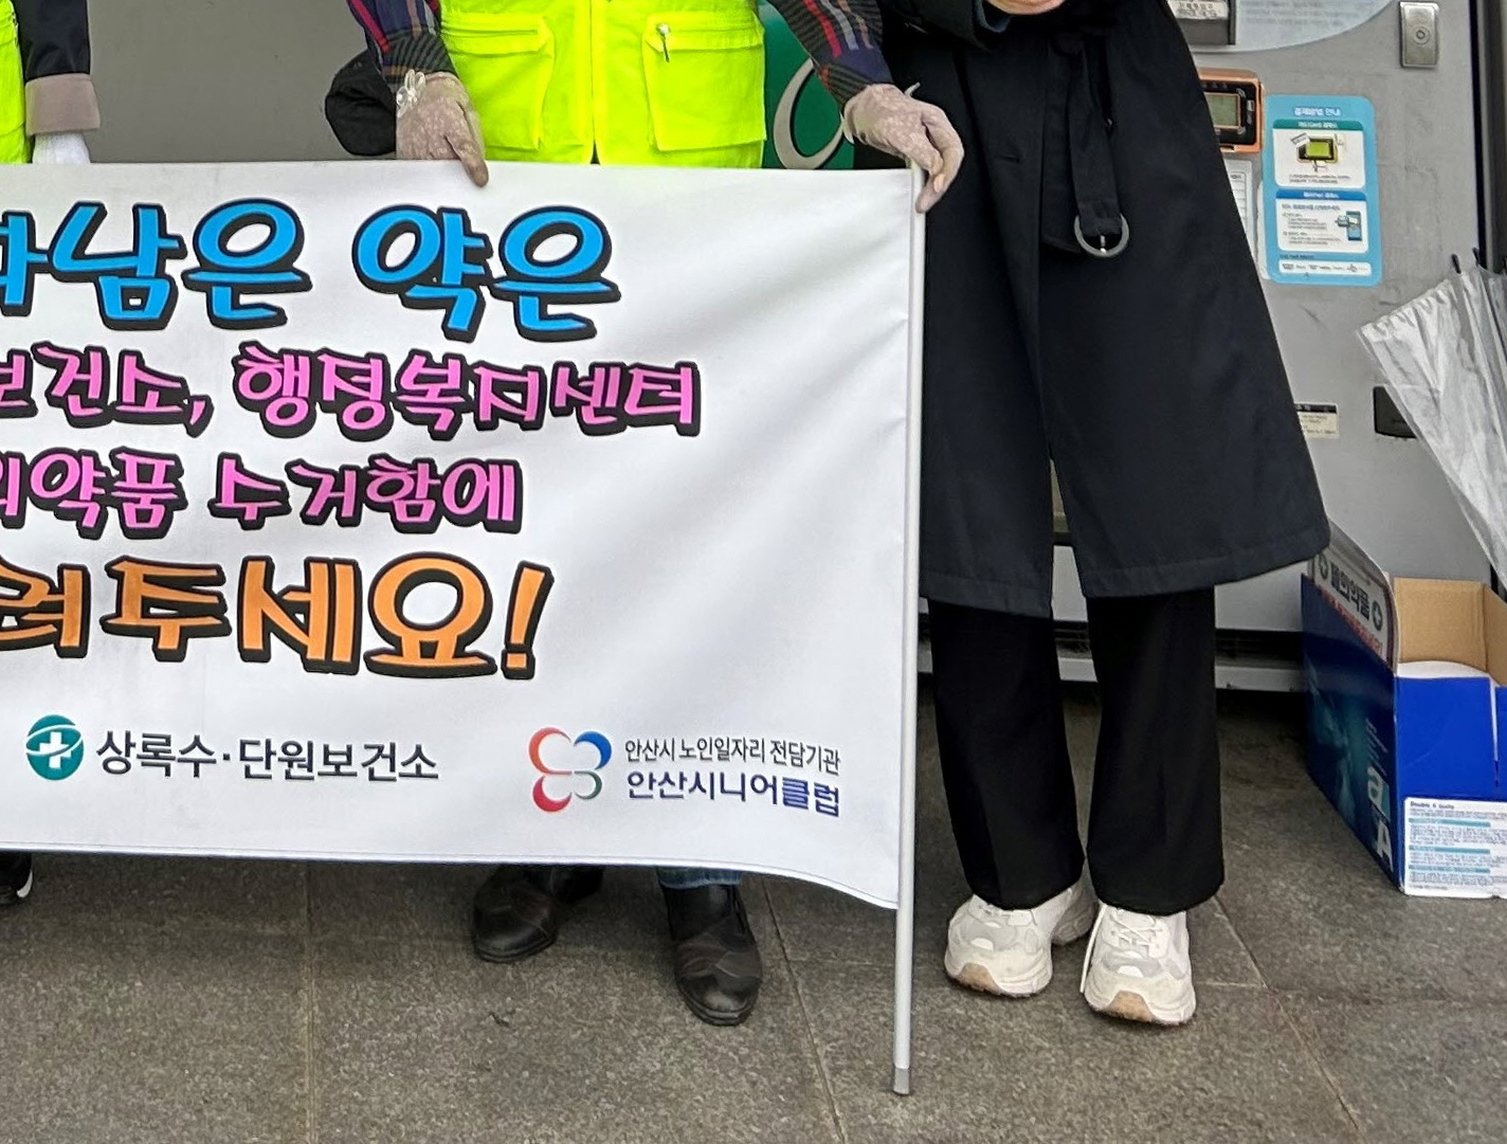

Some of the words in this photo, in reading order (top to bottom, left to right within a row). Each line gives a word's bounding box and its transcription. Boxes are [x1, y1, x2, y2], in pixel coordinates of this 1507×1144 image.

[351, 204, 621, 343] 약은
[231, 341, 703, 441] 행정복지센터
[208, 453, 527, 541] 수거함에
[625, 737, 677, 763] 안산시
[678, 736, 766, 764] 노인일자리
[769, 739, 841, 776] 전담기관
[627, 770, 840, 818] 안산시니어클럽
